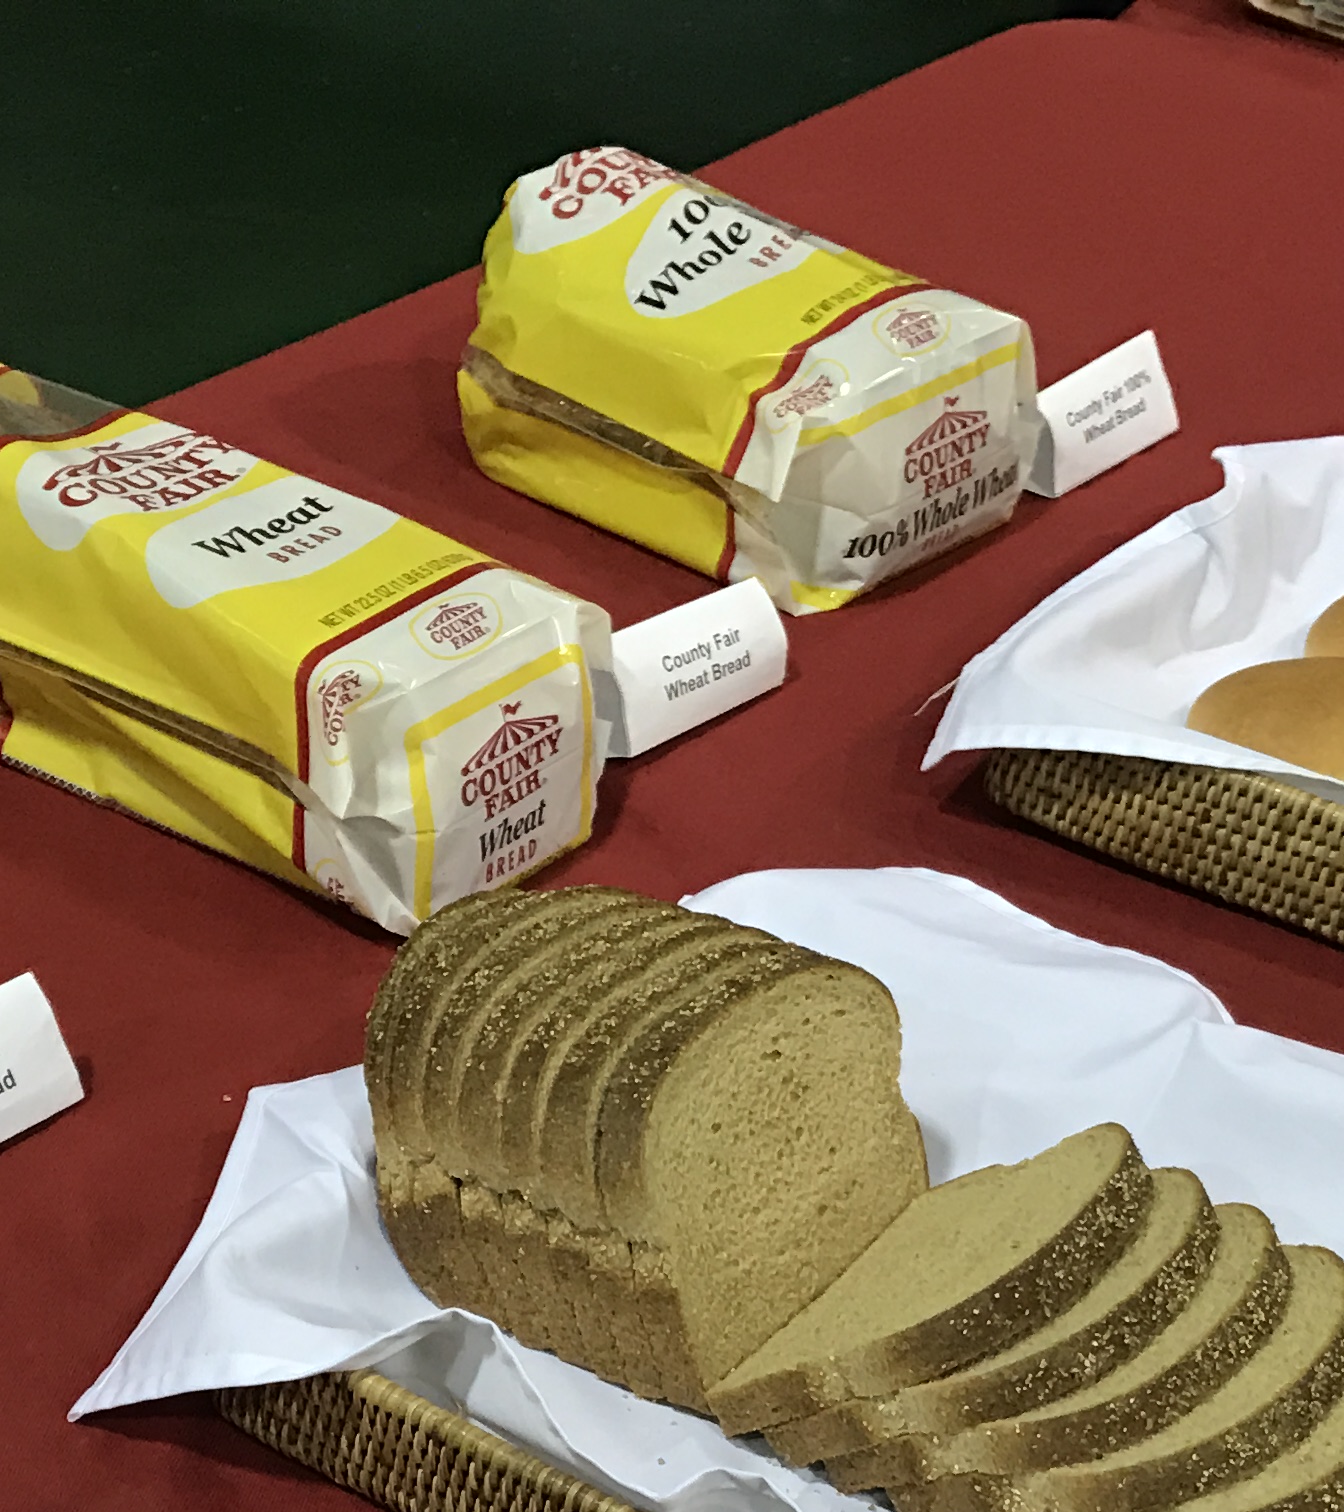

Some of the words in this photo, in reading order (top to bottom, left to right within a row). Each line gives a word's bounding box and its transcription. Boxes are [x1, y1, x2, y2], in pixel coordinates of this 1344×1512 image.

[634, 221, 751, 310] Whole
[58, 434, 240, 507] COUNTY
[904, 422, 990, 484] COUNTY
[922, 458, 973, 500] FAIR
[122, 468, 240, 512] FAIR
[191, 495, 334, 559] Wheat
[266, 525, 343, 564] BREAD
[843, 518, 909, 558] 100%
[913, 486, 970, 541] Whole
[430, 606, 488, 644] COUNTY
[449, 626, 487, 651] FAIR
[661, 642, 711, 672] County
[713, 627, 741, 651] Fair
[664, 670, 710, 701] Wheat
[712, 650, 751, 681] Bread
[461, 727, 563, 807] COUNTY
[484, 769, 541, 822] FAIR
[479, 799, 546, 862] Wheat
[486, 838, 538, 884] BREAD
